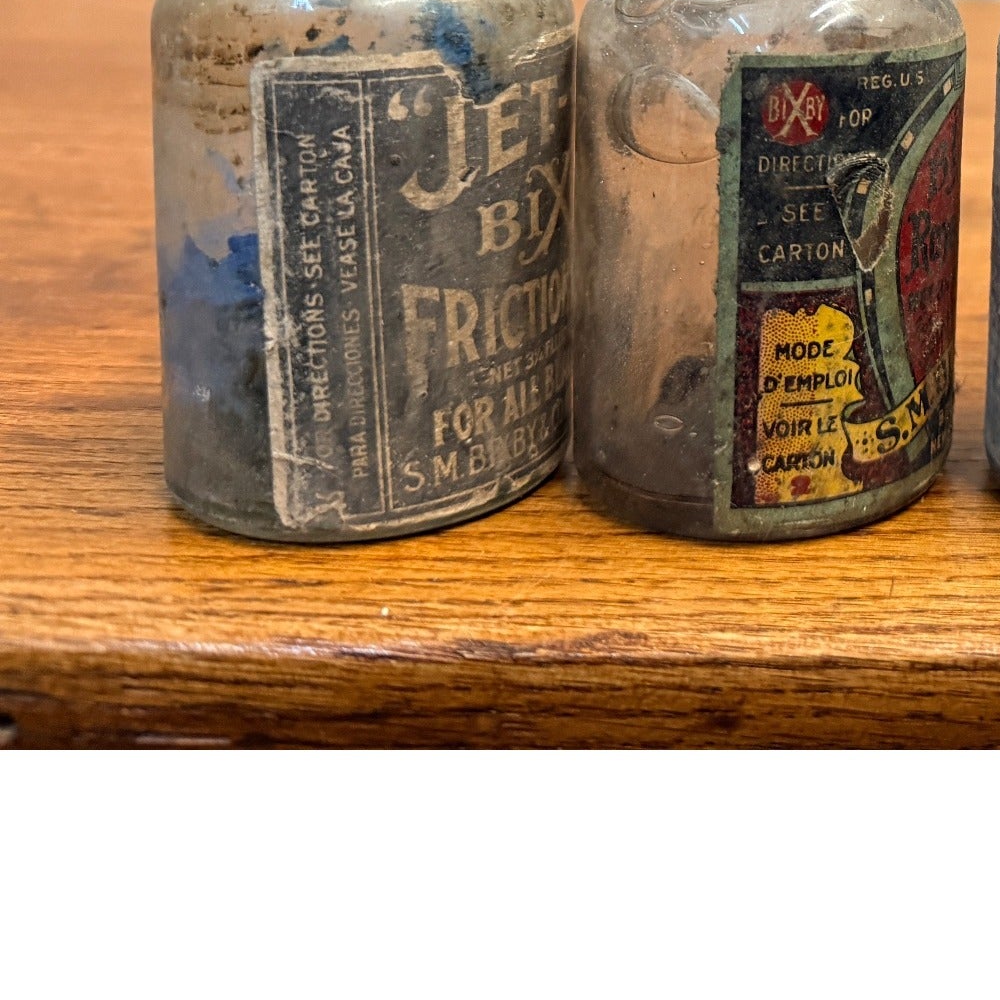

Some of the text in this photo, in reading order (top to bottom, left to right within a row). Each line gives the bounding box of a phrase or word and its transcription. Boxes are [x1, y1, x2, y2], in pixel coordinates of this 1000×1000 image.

[331, 124, 354, 185] CAJA
[298, 133, 320, 228] CARTON
[335, 187, 355, 221] LA
[780, 202, 827, 224] SEE
[301, 234, 324, 280] SEE
[335, 224, 358, 294] VEASE
[758, 239, 845, 264] CARTON
[304, 292, 332, 423] DIRECTIONS
[774, 339, 835, 361] MODE
[763, 368, 853, 394] D'EMPLOI
[432, 395, 496, 448] FOR
[762, 415, 839, 439] VOIR LE
[350, 430, 370, 479] PARA
[762, 448, 835, 474] CARTON
